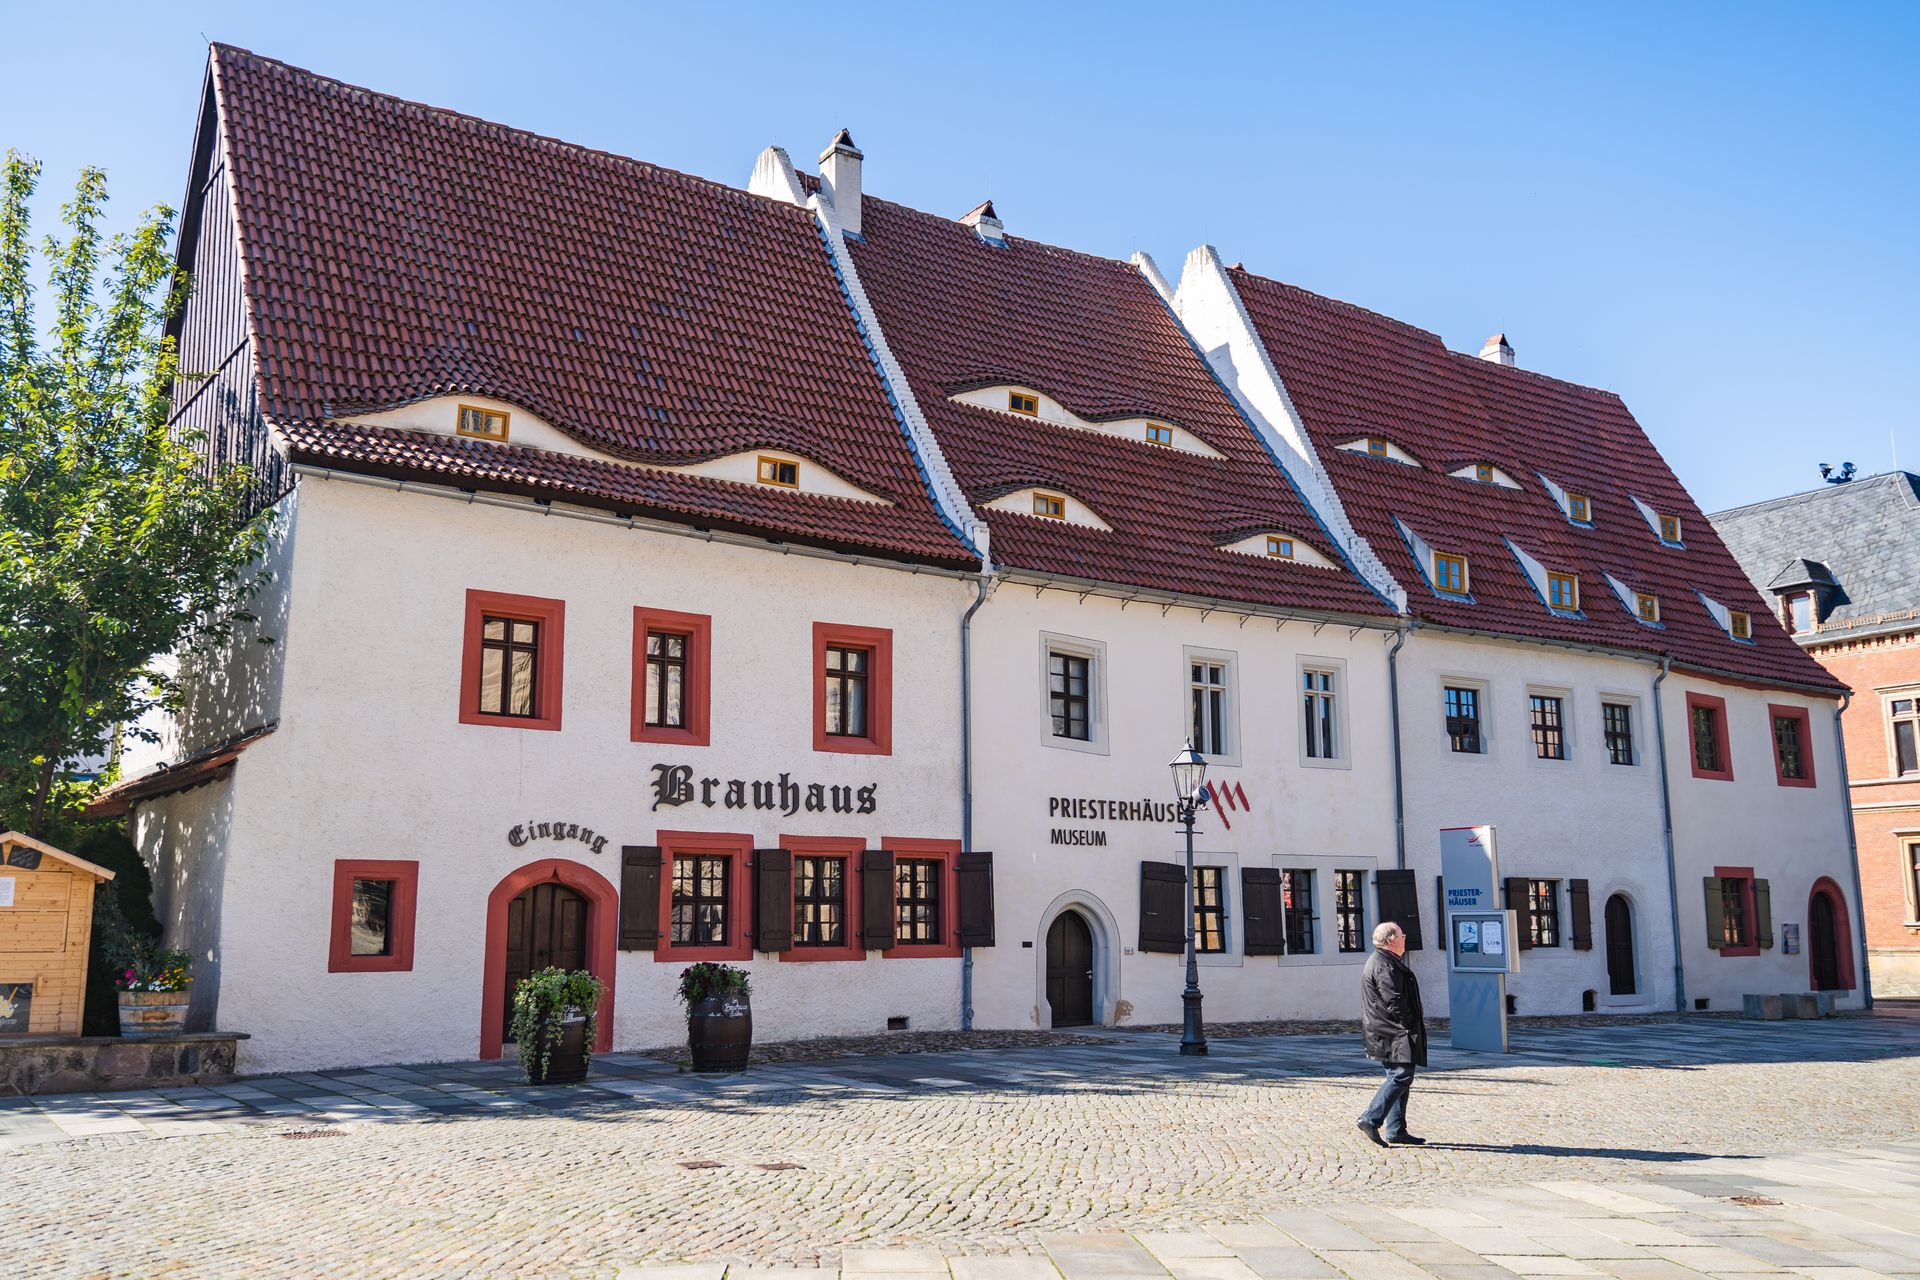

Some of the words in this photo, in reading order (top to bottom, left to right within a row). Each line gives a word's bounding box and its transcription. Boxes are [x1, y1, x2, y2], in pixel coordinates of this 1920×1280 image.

[650, 763, 878, 818] Brauhaus
[1049, 797, 1195, 824] PRIESTERHÄUSE
[508, 820, 609, 854] Eingang
[1050, 828, 1107, 847] MUSEUM
[1448, 888, 1484, 897] PRIESTER-
[1448, 896, 1478, 906] HÄUSER
